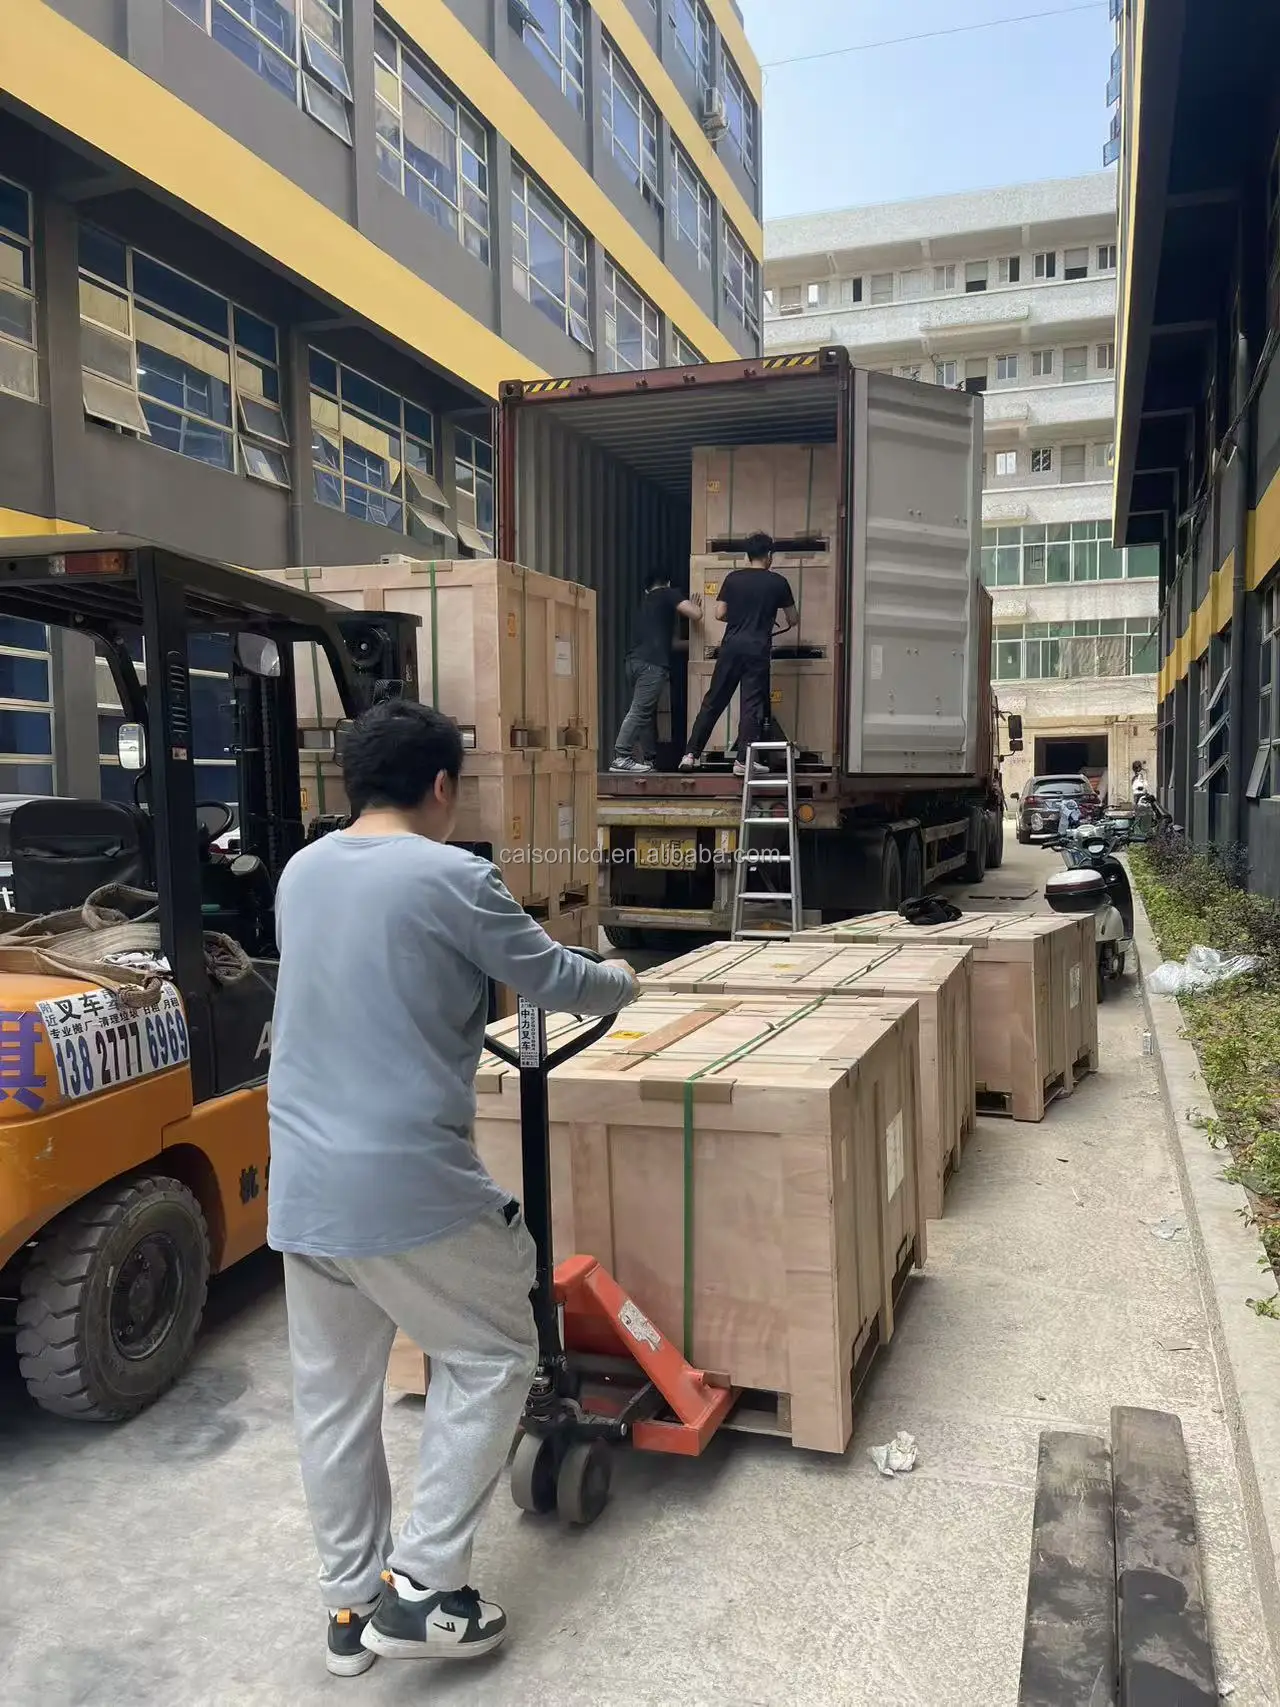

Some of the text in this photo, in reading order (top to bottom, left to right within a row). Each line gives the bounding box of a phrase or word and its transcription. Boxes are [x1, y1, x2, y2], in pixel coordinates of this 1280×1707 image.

[54, 993, 104, 1024] 叉车
[520, 1008, 531, 1051] 中力叉车
[56, 1035, 94, 1096] 138
[95, 1021, 143, 1086] 2777
[145, 1009, 188, 1069] 6969
